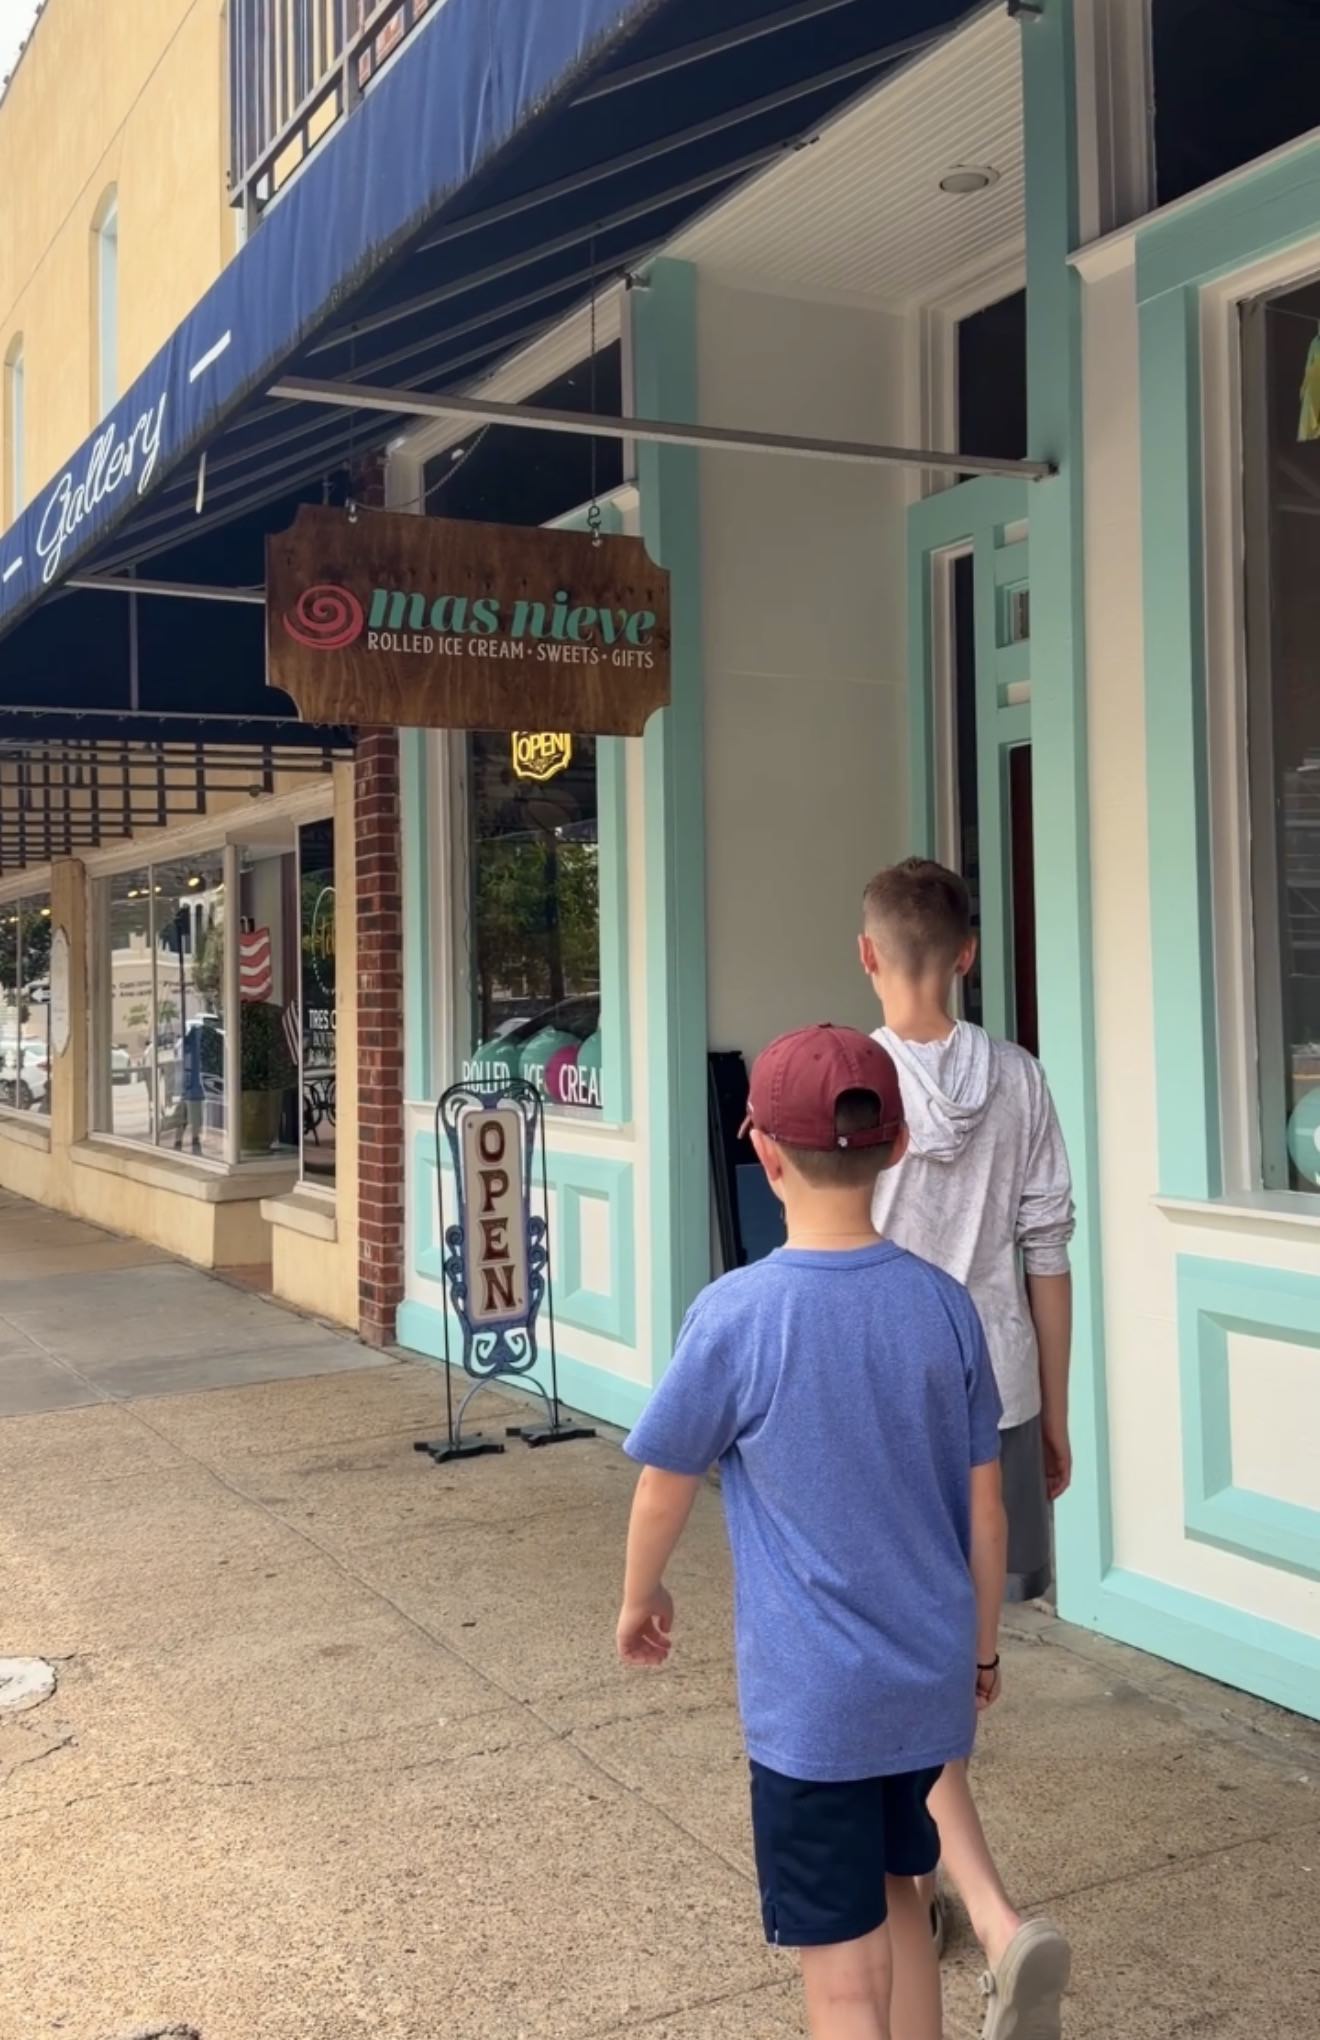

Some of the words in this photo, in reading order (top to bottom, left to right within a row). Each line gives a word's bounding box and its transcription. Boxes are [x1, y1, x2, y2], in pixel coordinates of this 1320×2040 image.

[36, 391, 167, 584] Gallery
[367, 587, 500, 635] mas
[511, 590, 656, 646] nieve
[367, 631, 434, 654] ROLLED
[439, 636, 464, 656] ICE
[467, 637, 525, 660] CREAM
[536, 642, 599, 665] SWEETS
[611, 648, 654, 669] GIFTS
[518, 732, 564, 762] OPEN
[462, 1060, 511, 1094] ROLLED
[558, 1063, 603, 1107] CREA
[478, 1119, 516, 1312] OPEN
